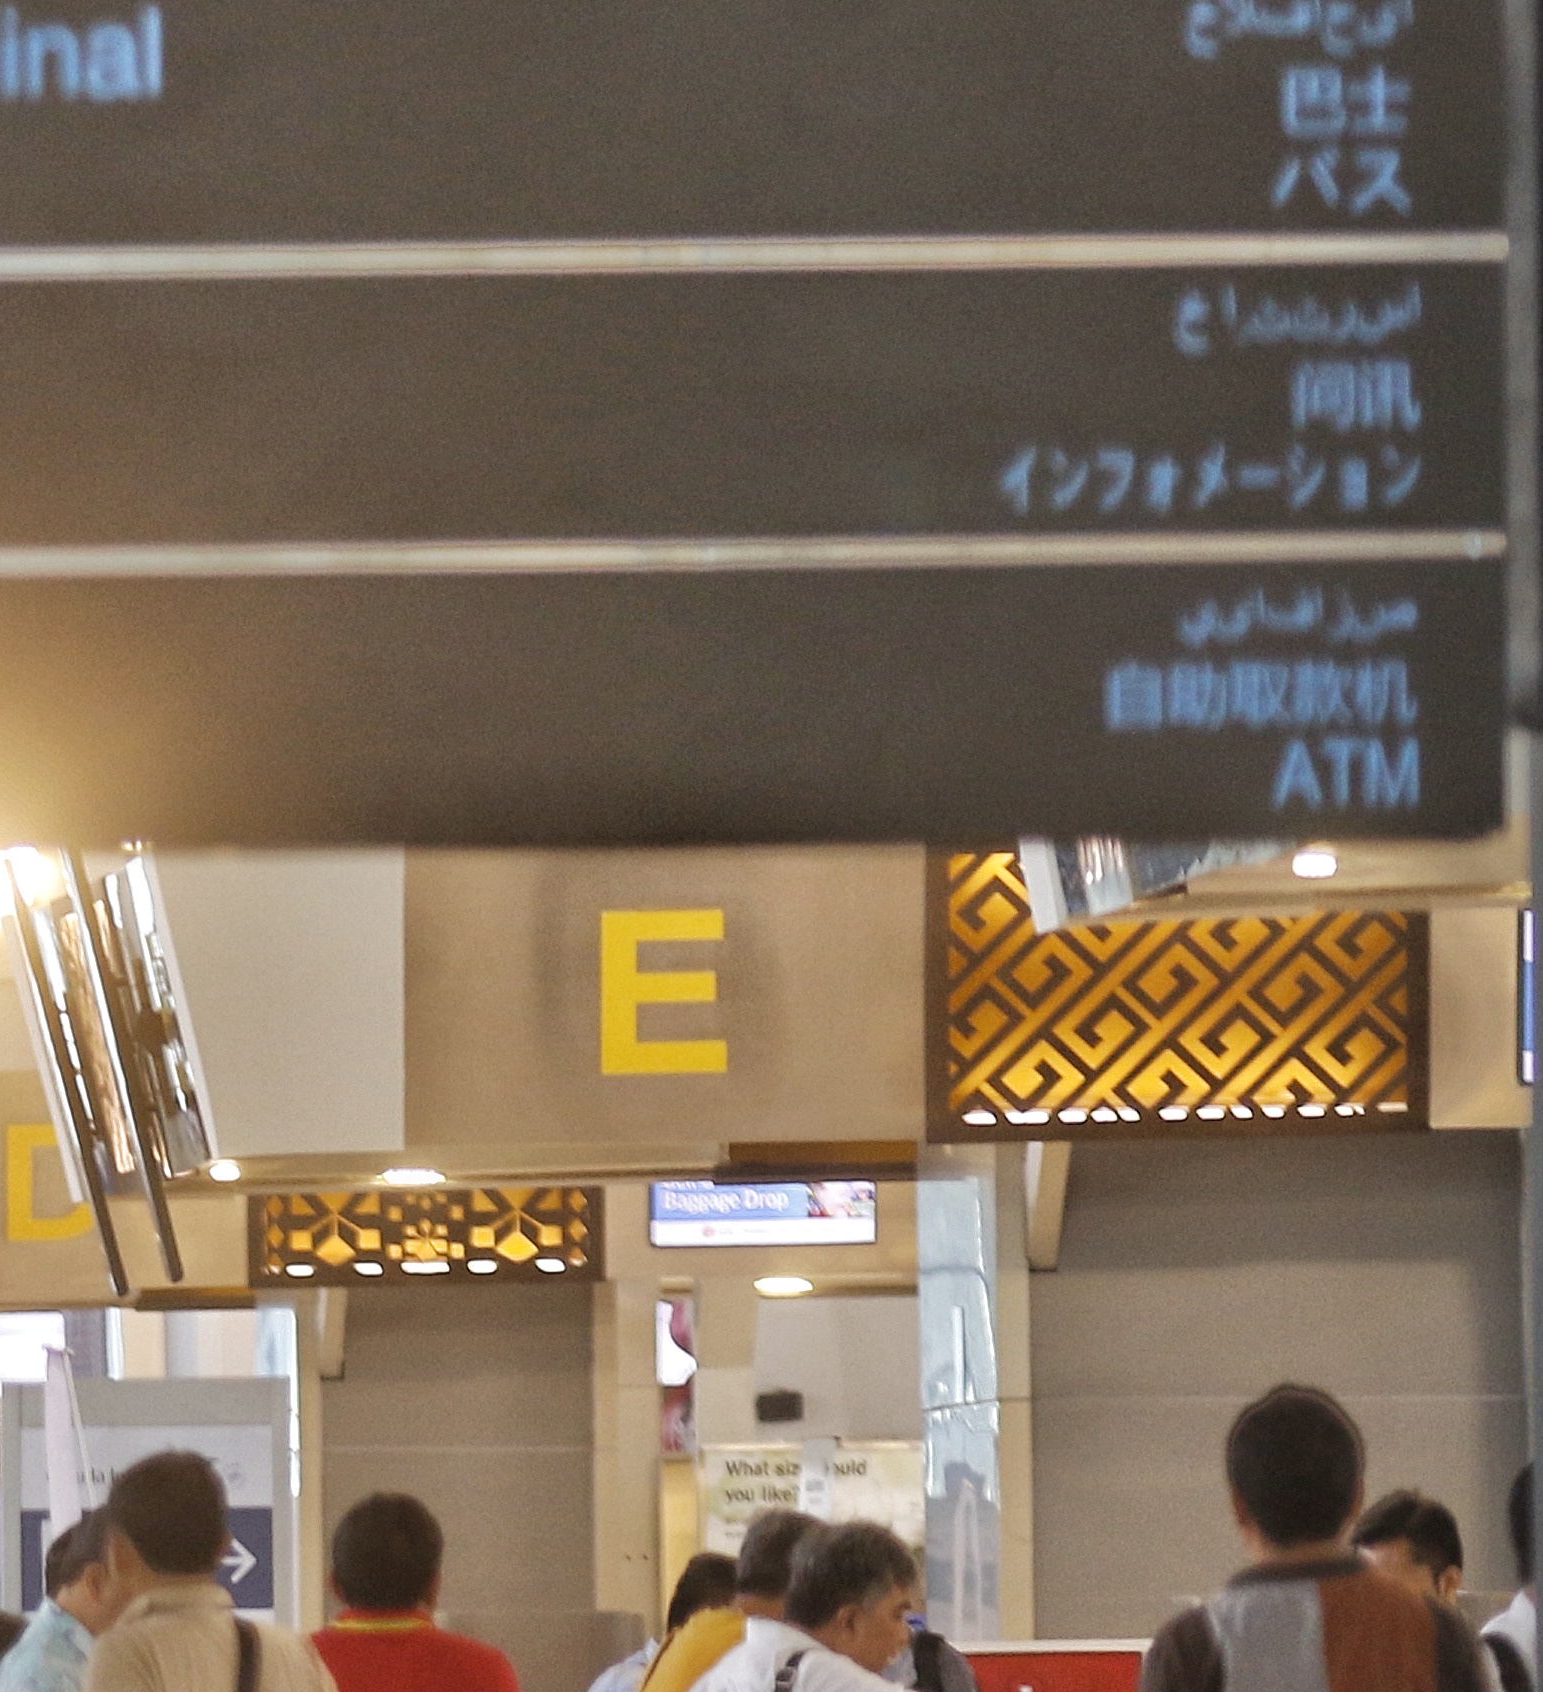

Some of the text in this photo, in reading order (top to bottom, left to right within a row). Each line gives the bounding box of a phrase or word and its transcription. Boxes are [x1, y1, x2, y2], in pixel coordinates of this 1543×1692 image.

[1280, 66, 1408, 135] 巴士
[1272, 147, 1410, 212] バス
[1272, 738, 1421, 807] ATM
[601, 909, 728, 1074] E
[663, 1188, 790, 1214] Baggage Drop
[725, 1489, 756, 1503] you
[726, 1461, 769, 1476] What
[775, 1461, 800, 1476] siz
